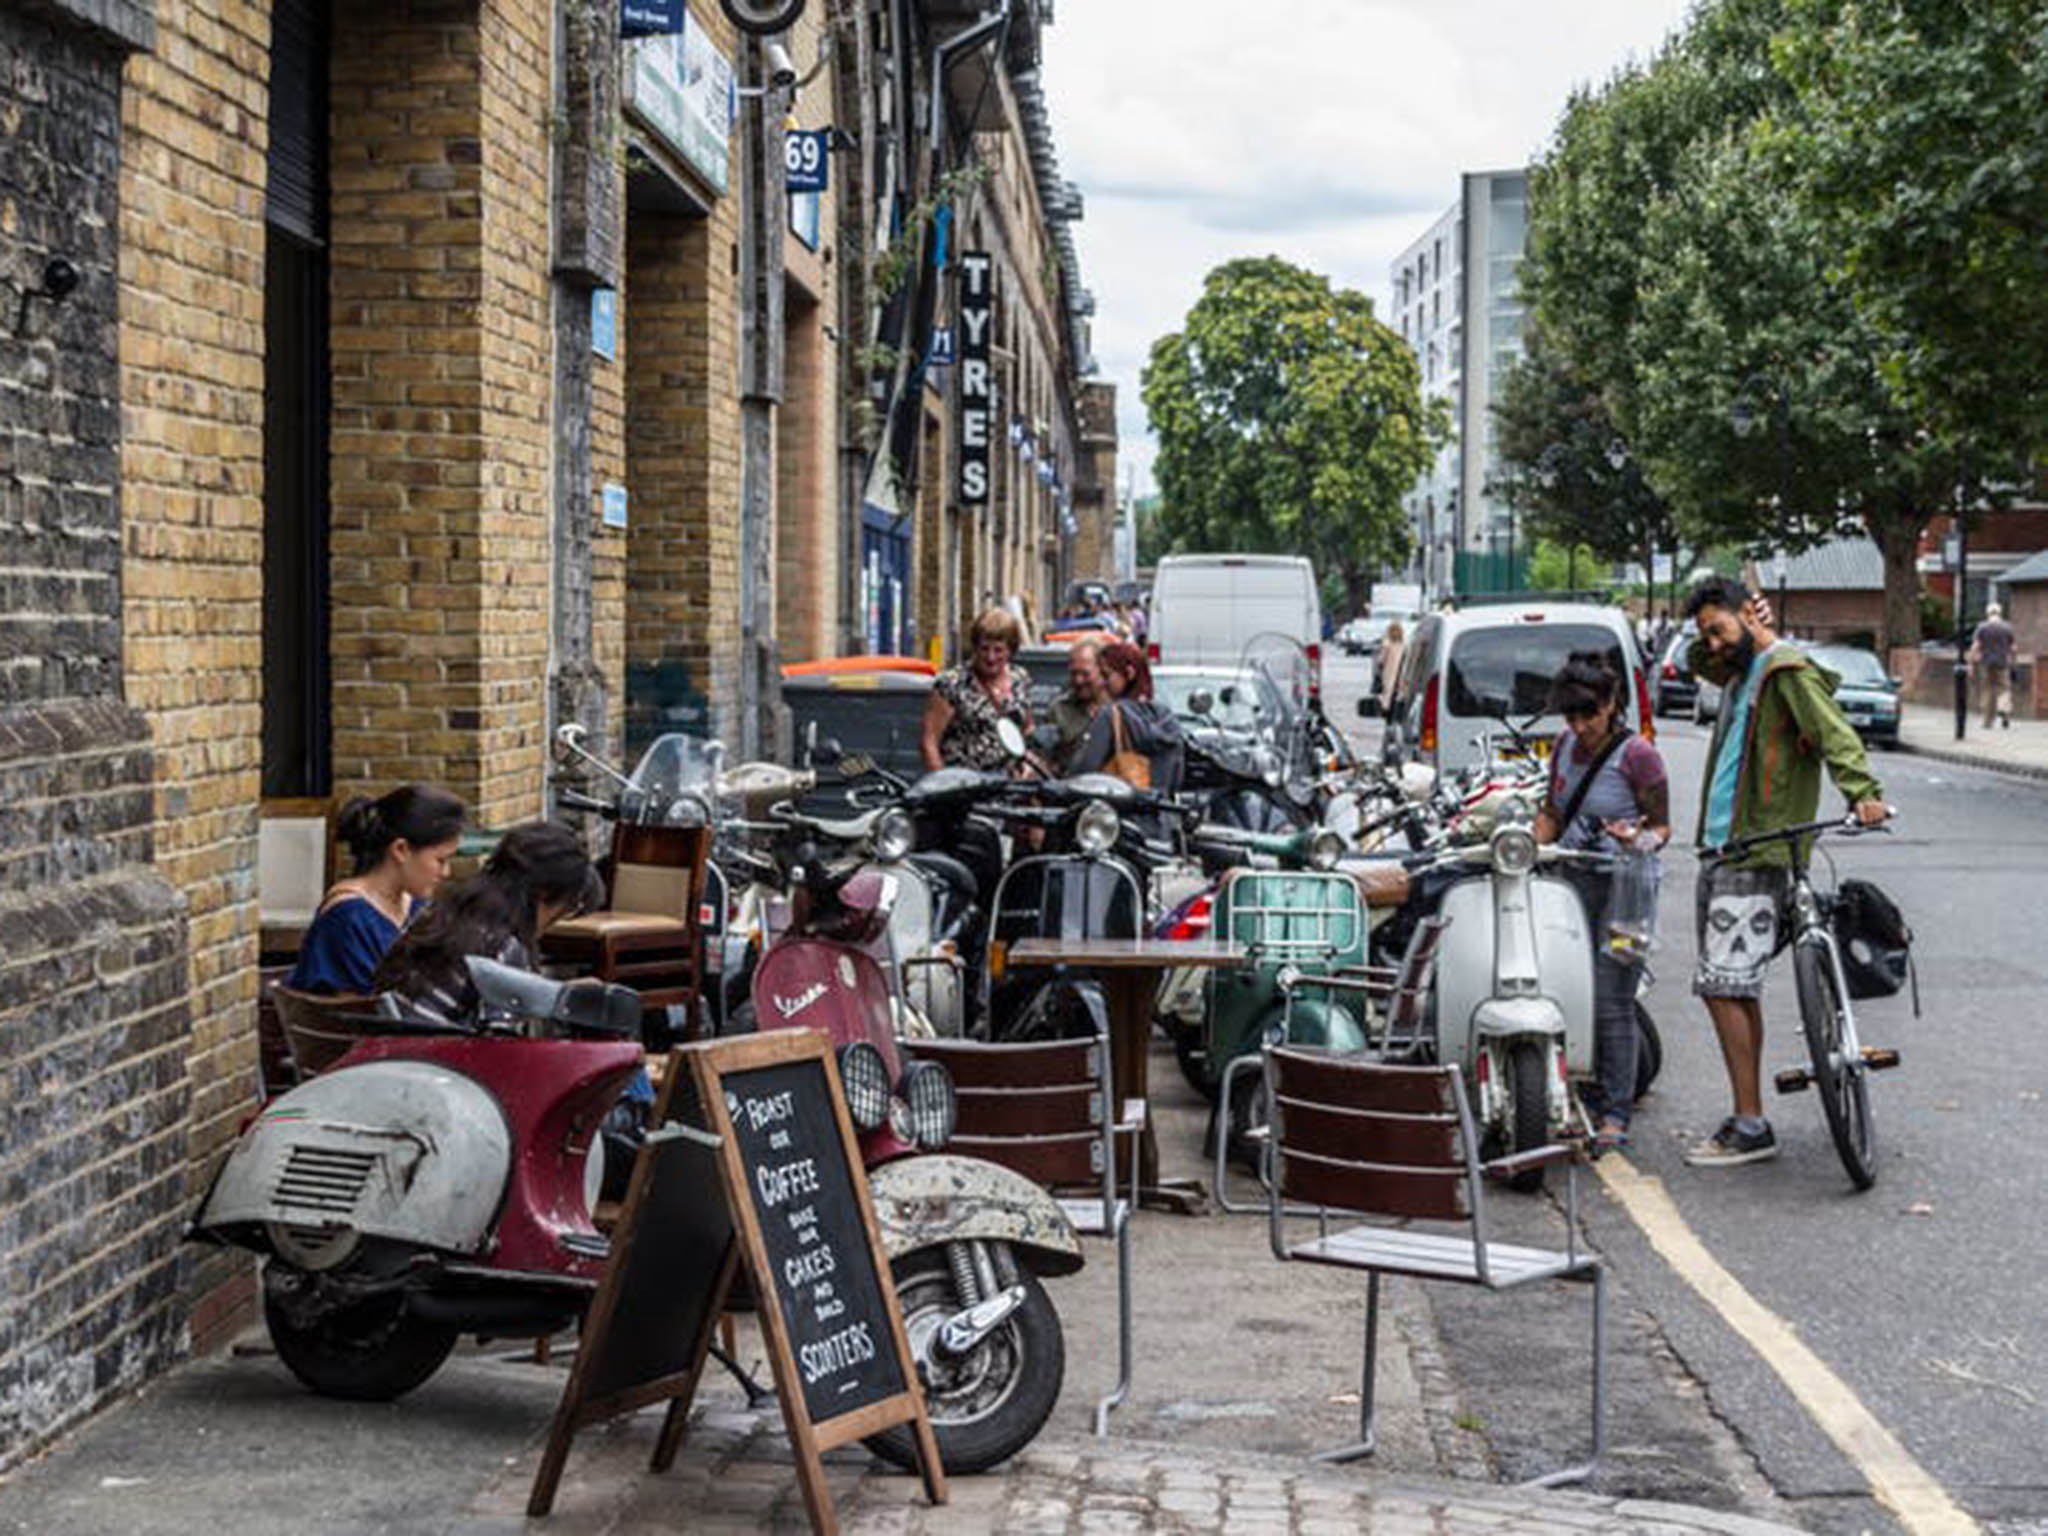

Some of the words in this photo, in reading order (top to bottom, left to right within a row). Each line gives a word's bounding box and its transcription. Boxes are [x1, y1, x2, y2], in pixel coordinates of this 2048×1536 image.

[785, 133, 820, 173] 69
[962, 256, 989, 499] TYRES
[745, 1090, 794, 1132] ROAST
[756, 1158, 820, 1207] COFFEE
[784, 1244, 837, 1288] CAKES
[800, 1321, 876, 1384] SCOOTERS
